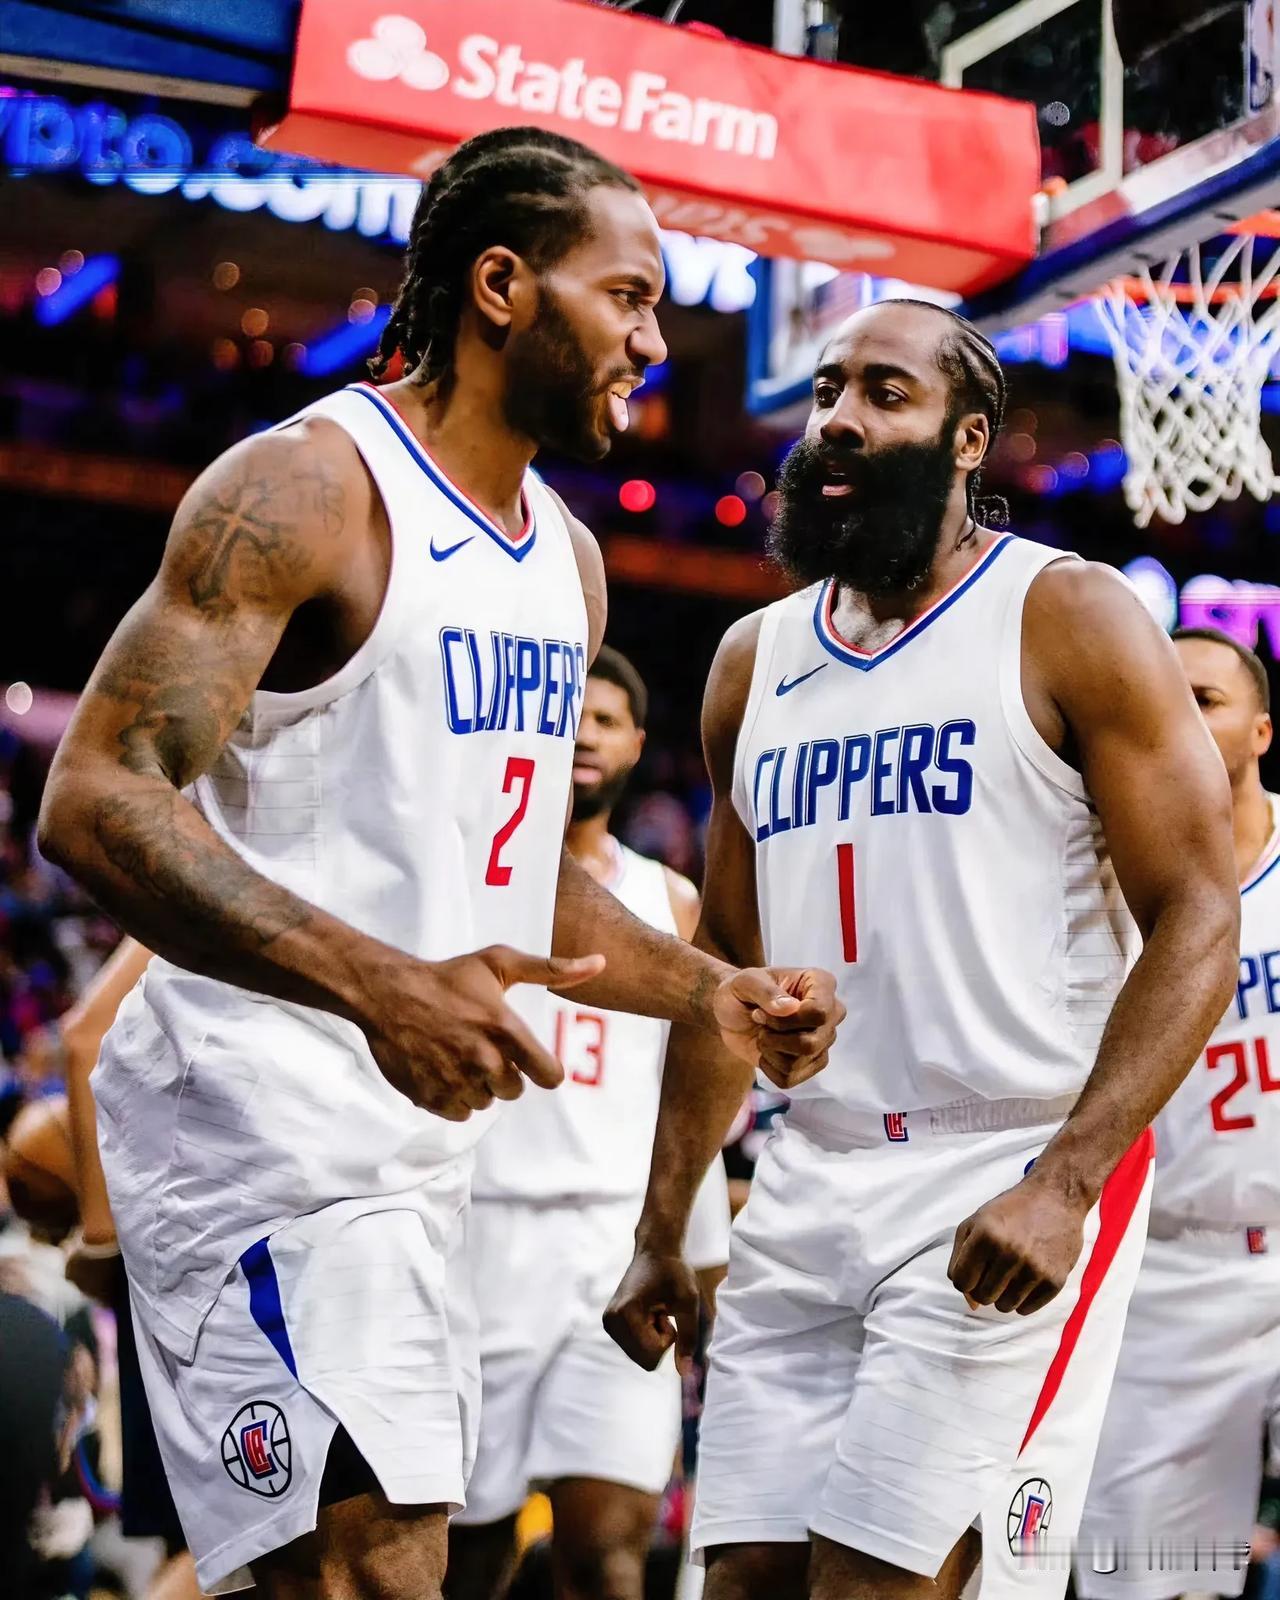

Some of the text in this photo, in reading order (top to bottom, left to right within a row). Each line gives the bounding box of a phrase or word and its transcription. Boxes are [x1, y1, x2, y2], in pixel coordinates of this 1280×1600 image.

[485, 756, 535, 886] 2
[753, 718, 976, 842] CLIPPERS
[836, 843, 857, 962] 1
[554, 1010, 606, 1086] 13
